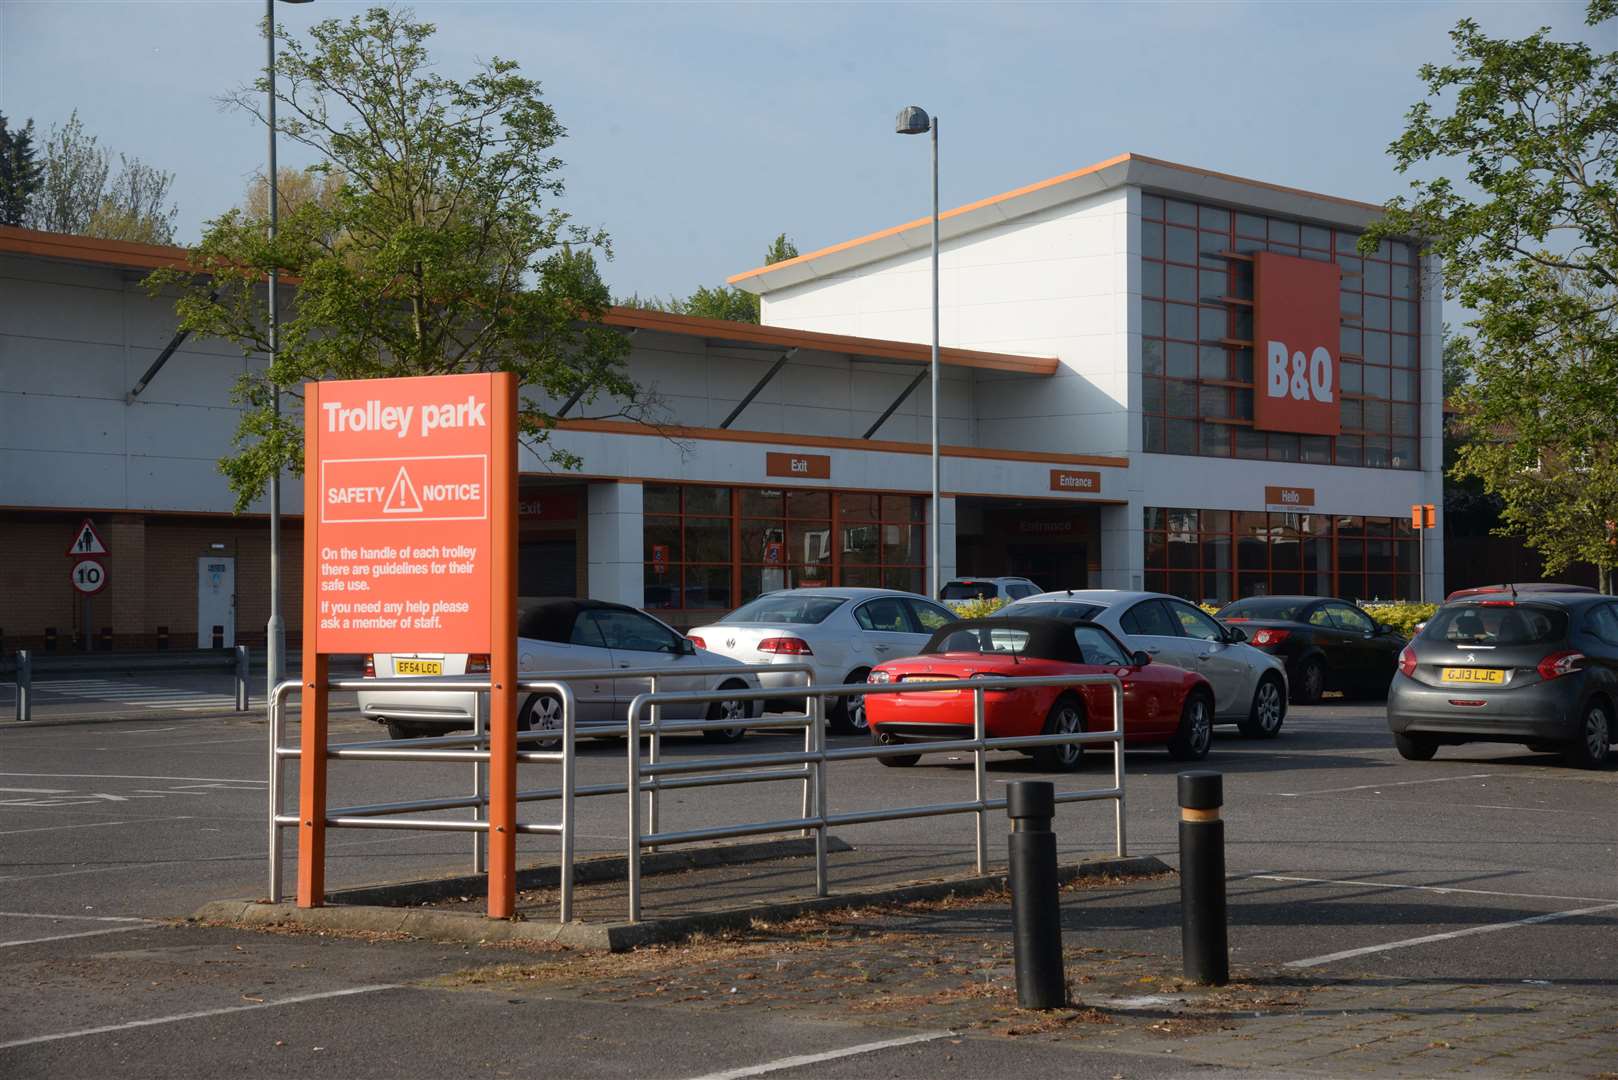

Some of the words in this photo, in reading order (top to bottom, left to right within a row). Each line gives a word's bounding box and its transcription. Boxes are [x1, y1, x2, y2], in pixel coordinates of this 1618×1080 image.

[1267, 340, 1333, 403] B&Q
[322, 400, 414, 438] Trolley
[421, 395, 487, 437] park
[791, 459, 808, 472] Exit
[1060, 474, 1092, 487] Entrance
[328, 487, 385, 504] SAFETY
[423, 484, 480, 501] NOTICE
[1281, 489, 1300, 503] Hello
[322, 547, 337, 560] On
[340, 547, 357, 559] the
[360, 547, 397, 559] handle
[399, 546, 411, 559] of
[413, 546, 439, 558] each
[442, 545, 476, 560] trolley
[78, 568, 100, 584] 10
[321, 563, 349, 576] there
[352, 564, 369, 575] are
[372, 562, 428, 578] guidelines
[431, 562, 446, 574] for
[449, 561, 474, 574] their
[321, 579, 344, 591] safe
[347, 580, 370, 591] use.
[321, 600, 329, 613] If
[331, 603, 351, 616] you
[354, 600, 381, 613] need
[383, 603, 403, 615] any
[406, 600, 430, 615] help
[432, 600, 469, 614] please
[321, 617, 340, 629] ask
[343, 619, 350, 628] a
[352, 617, 397, 628] member
[400, 616, 411, 628] of
[414, 616, 442, 628] staff.
[399, 661, 419, 673] EF54
[1474, 671, 1496, 681] LJC
